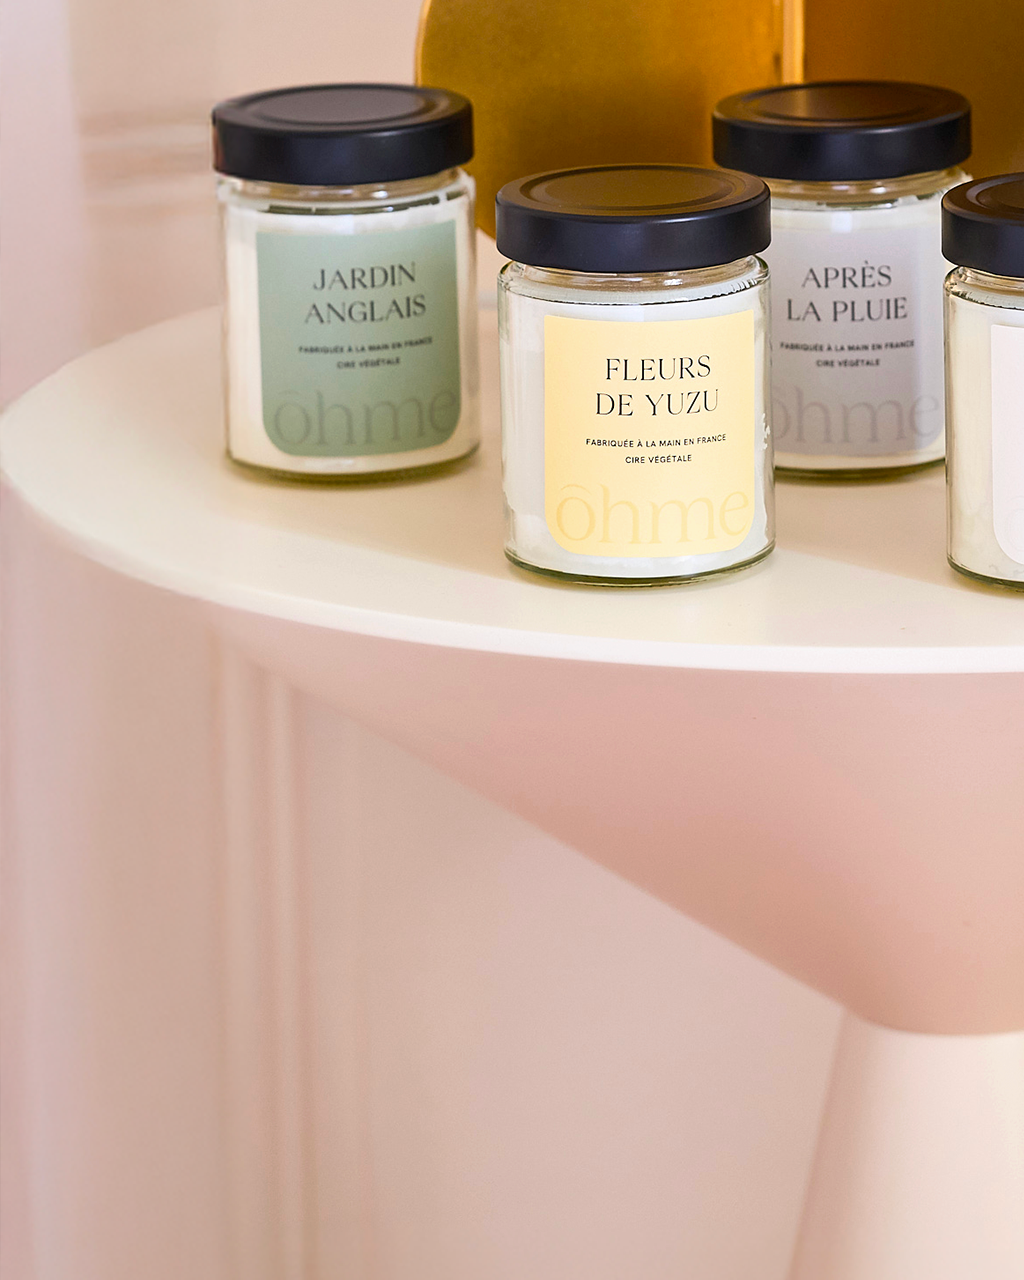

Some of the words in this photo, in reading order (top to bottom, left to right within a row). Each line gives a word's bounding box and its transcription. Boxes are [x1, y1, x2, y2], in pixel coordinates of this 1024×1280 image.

[313, 262, 416, 290] JARDIN
[801, 260, 892, 289] APRÈS
[305, 295, 426, 324] ANGLAIS
[787, 298, 821, 321] LA
[833, 297, 908, 322] PLUIE
[299, 345, 344, 354] FABRIQUÉE
[348, 344, 353, 353] À
[356, 345, 365, 353] LA
[369, 343, 389, 352] MAIN
[404, 336, 433, 348] FRANCE
[780, 342, 824, 352] FABRIQUÉE
[827, 343, 832, 351] À
[835, 344, 845, 352] LA
[885, 339, 915, 349] FRANCE
[337, 360, 356, 369] CIRE
[359, 357, 400, 369] VÉGÉTALE
[606, 355, 711, 381] FLEURS
[838, 358, 880, 368] VÉGÉTALE
[596, 392, 634, 416] DE
[645, 389, 719, 416] YUZU
[586, 438, 634, 447] FABRIQUÉE
[637, 438, 643, 447] À
[660, 439, 681, 447] MAIN
[697, 433, 726, 444] FRANCE
[625, 456, 645, 464] CIRE
[648, 454, 692, 464] VÉGÉTALE
